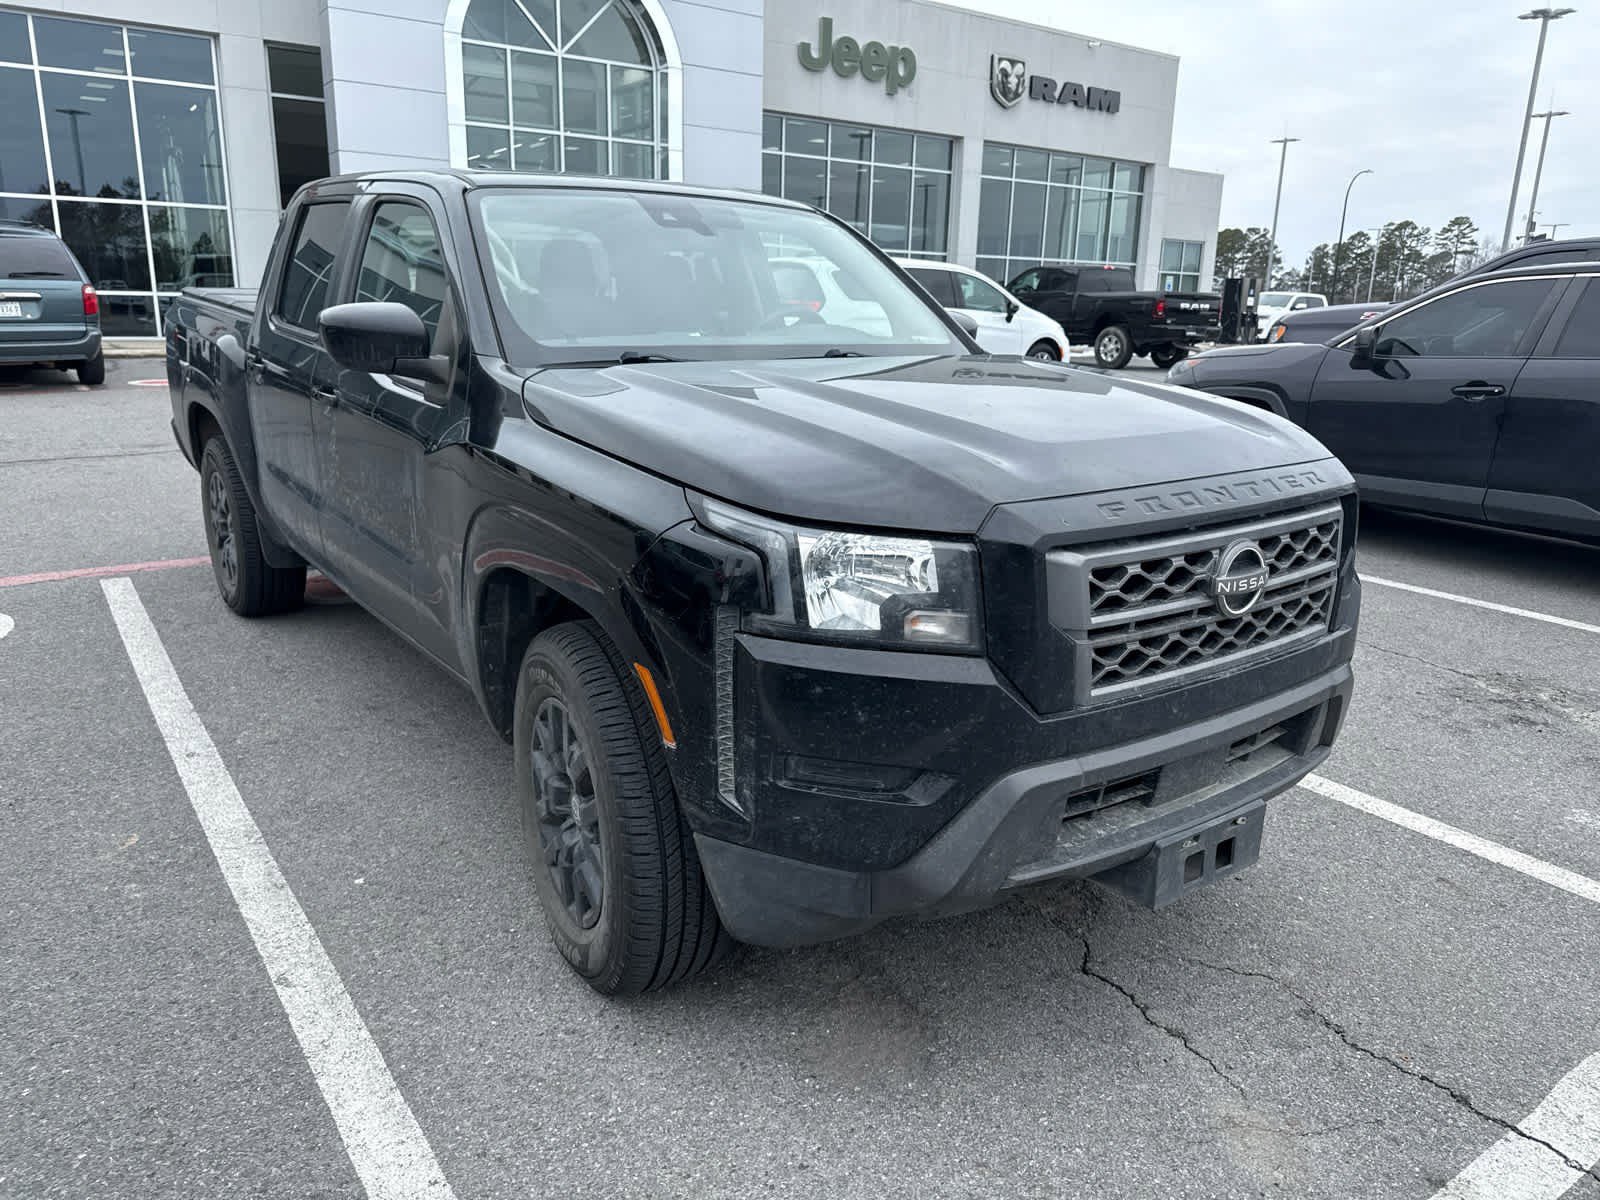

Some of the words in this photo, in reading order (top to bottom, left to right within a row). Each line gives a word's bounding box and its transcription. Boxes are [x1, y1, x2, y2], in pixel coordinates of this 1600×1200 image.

[798, 17, 917, 96] Jeep
[1029, 75, 1120, 113] RAM
[1180, 302, 1211, 311] RAM
[1096, 471, 1327, 519] FRONTIER
[1217, 573, 1269, 593] NISSA
